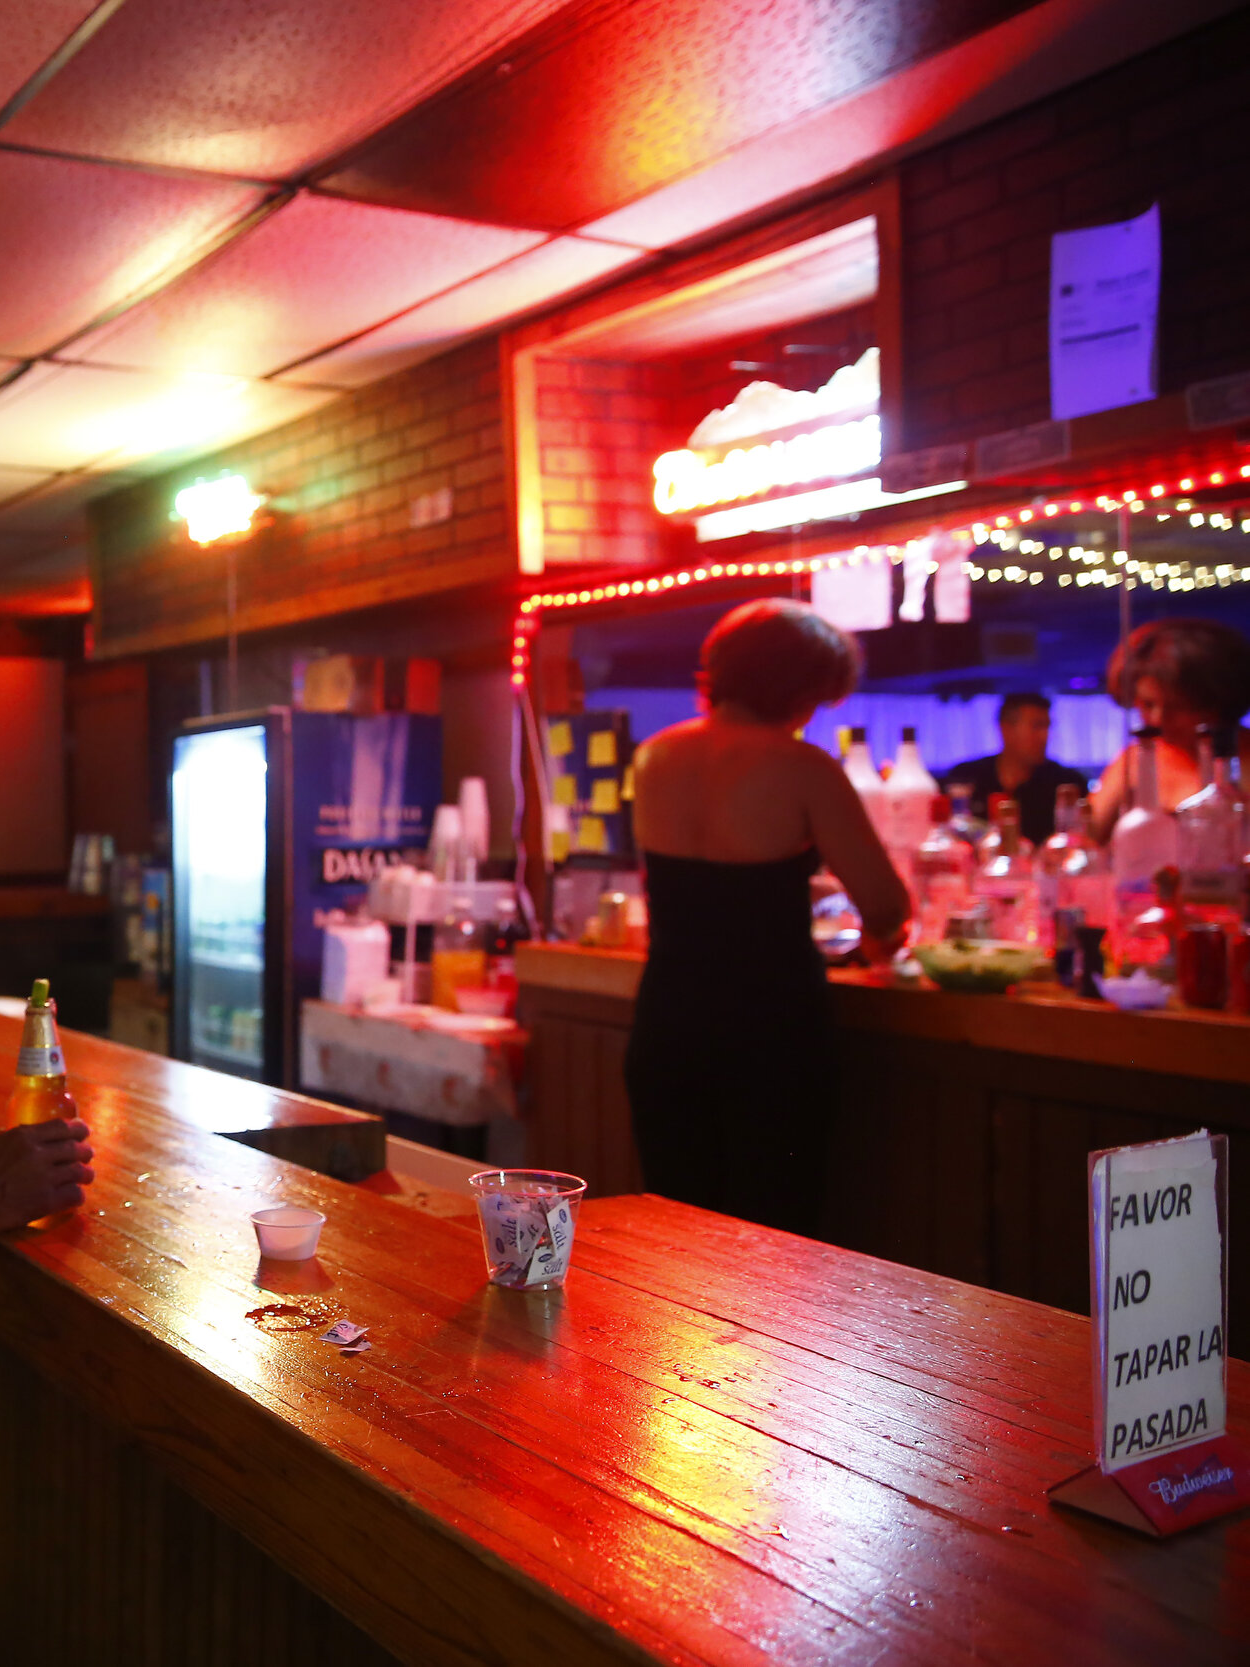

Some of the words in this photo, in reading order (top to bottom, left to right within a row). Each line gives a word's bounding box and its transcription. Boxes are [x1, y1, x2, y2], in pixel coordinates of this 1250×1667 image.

[1110, 1183, 1193, 1232] FAVOR
[501, 1218, 518, 1248] salt
[552, 1224, 567, 1250] salt
[541, 1258, 563, 1276] salt
[1113, 1269, 1151, 1311] NO
[1113, 1333, 1191, 1388] TAPAR
[1198, 1324, 1223, 1362] LA
[1111, 1397, 1209, 1459] PASADA
[1148, 1466, 1234, 1505] Budweiser
